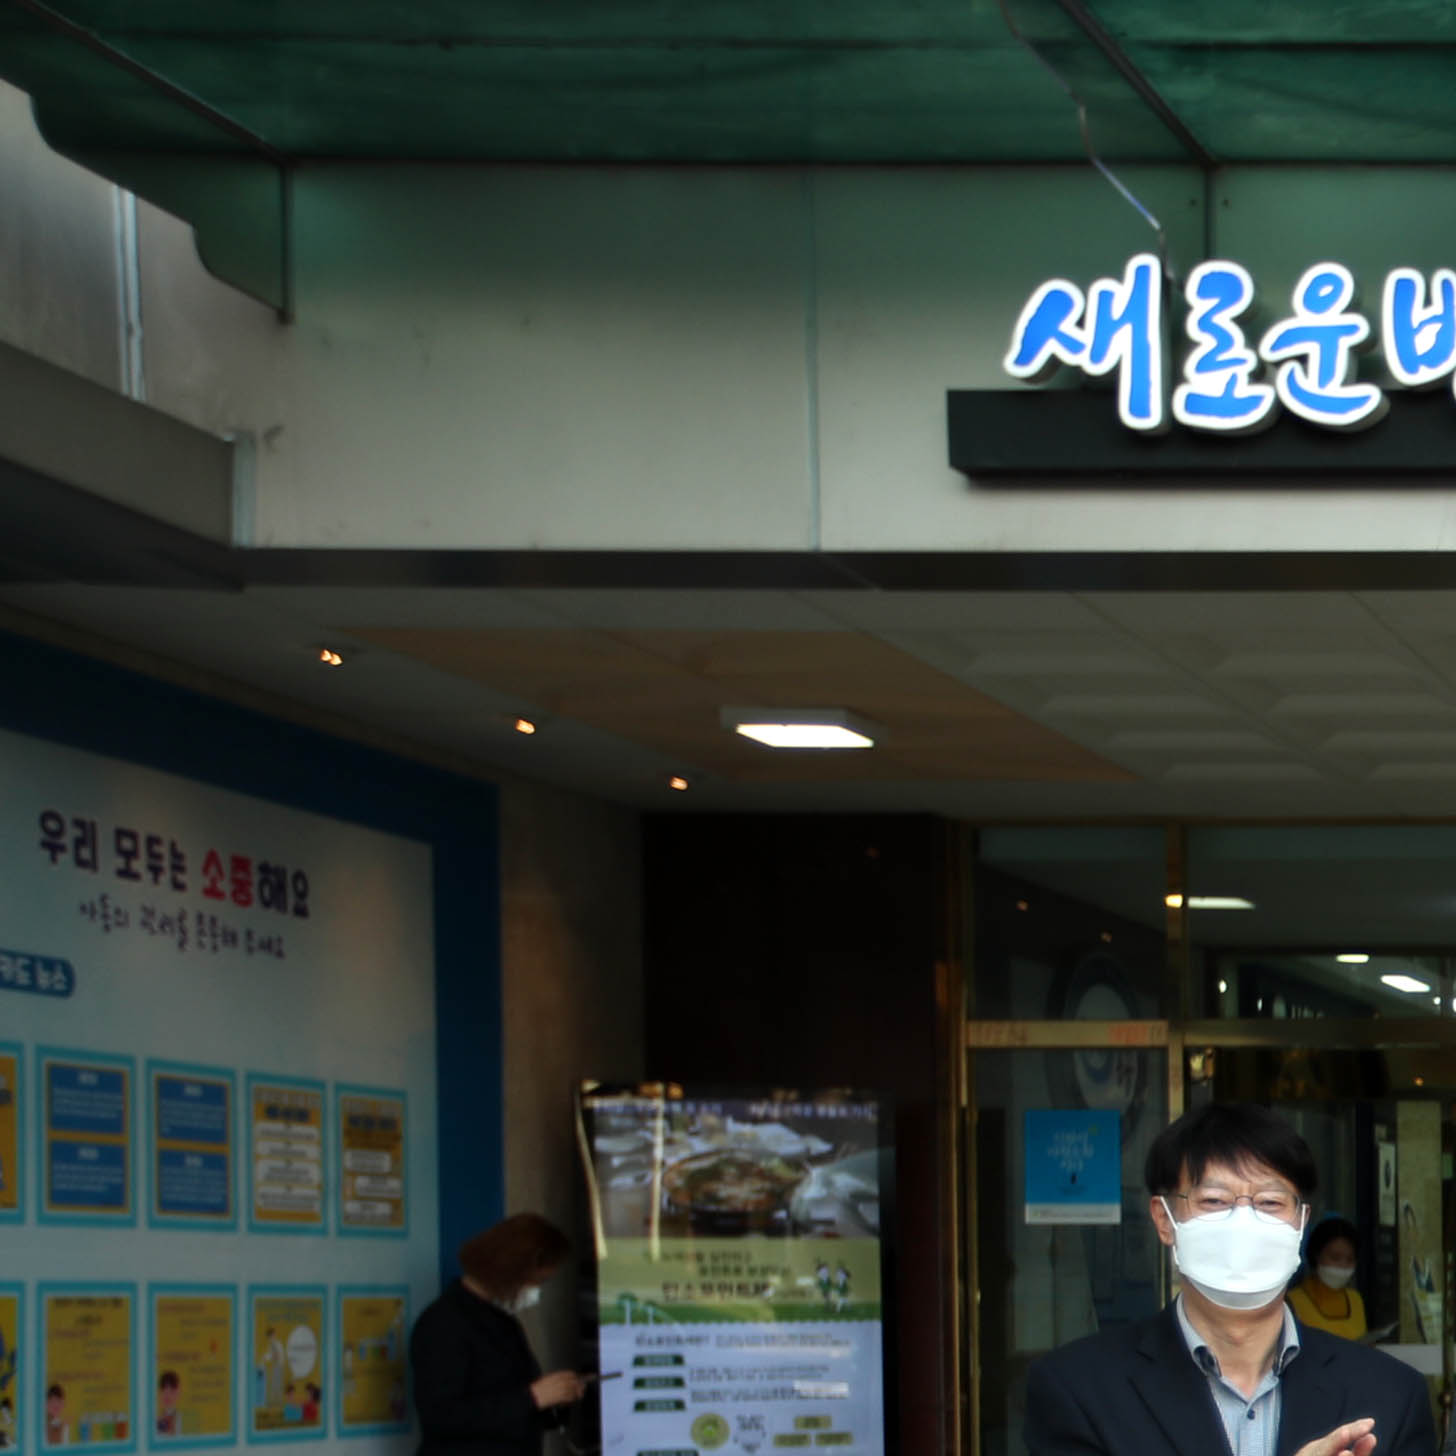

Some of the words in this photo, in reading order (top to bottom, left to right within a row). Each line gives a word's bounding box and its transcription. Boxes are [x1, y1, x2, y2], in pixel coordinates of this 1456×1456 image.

[1003, 253, 1386, 433] 새로운
[39, 810, 98, 874] 우리
[115, 827, 188, 892] 모두는
[201, 848, 310, 918] 소중해요
